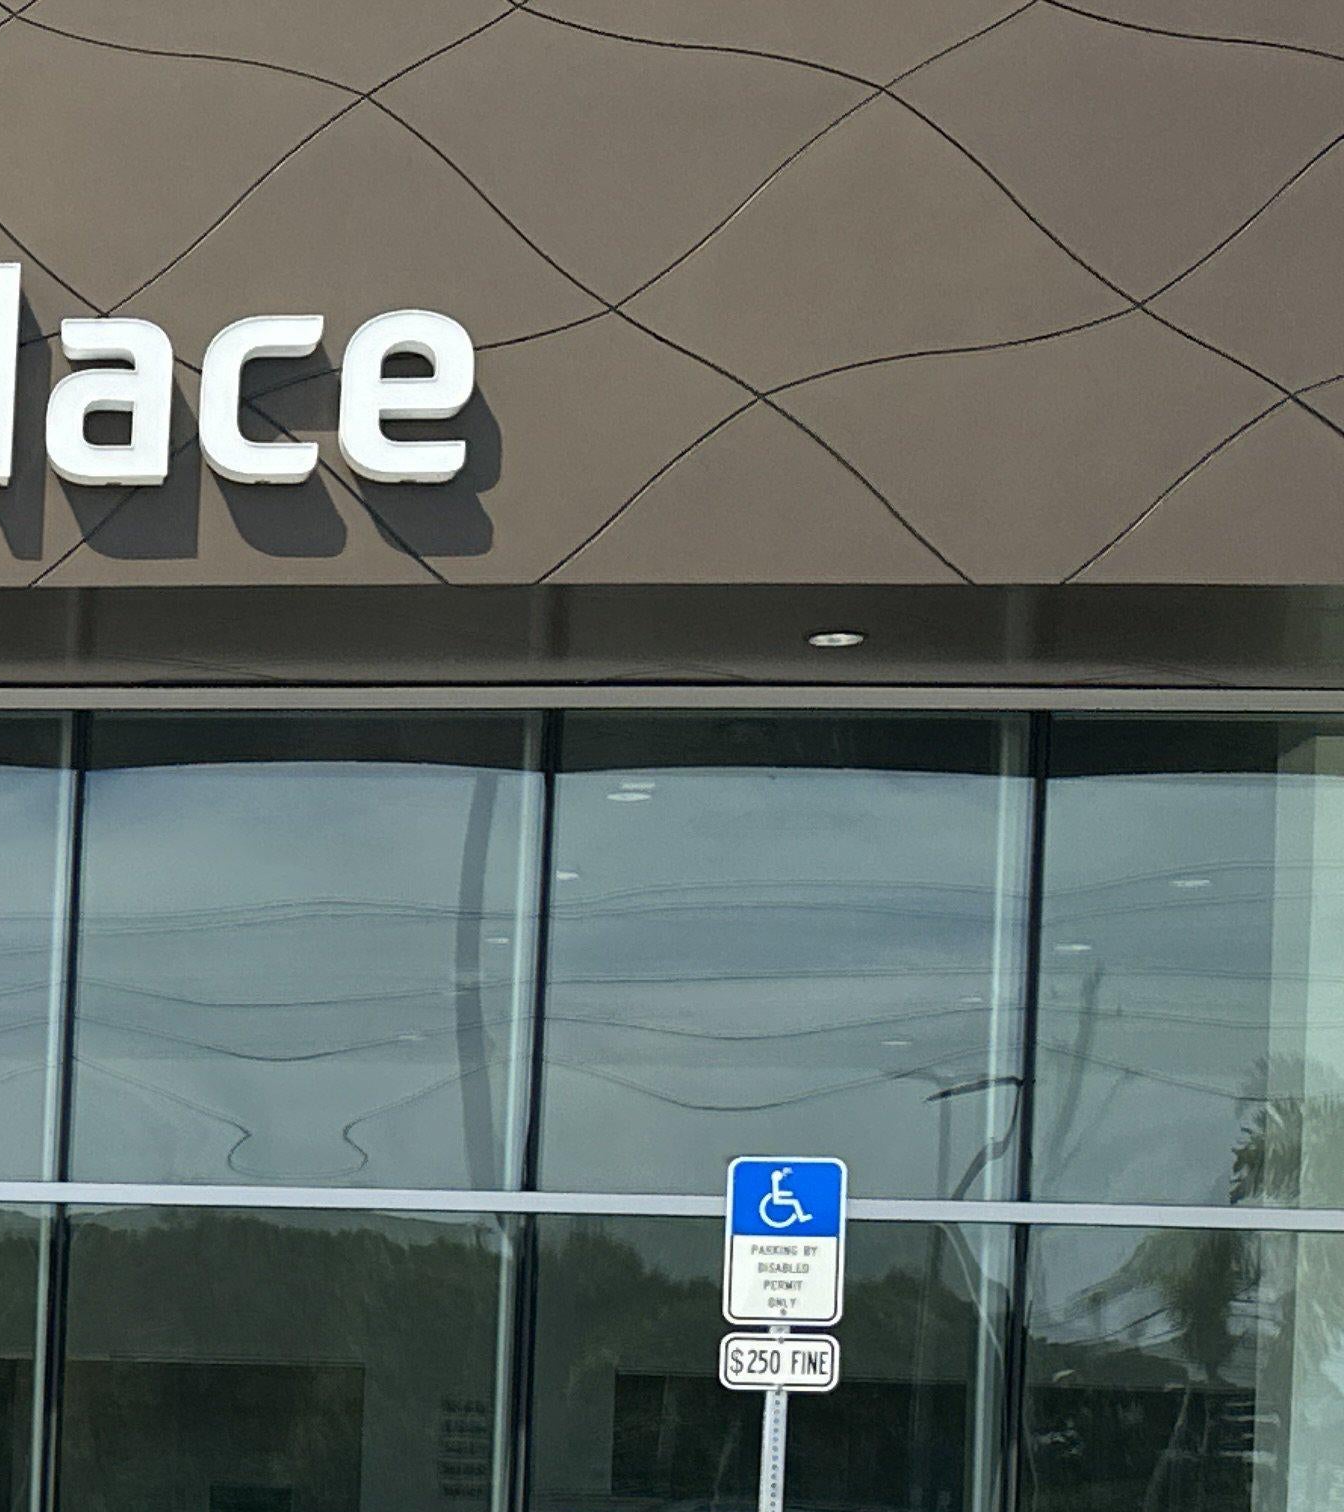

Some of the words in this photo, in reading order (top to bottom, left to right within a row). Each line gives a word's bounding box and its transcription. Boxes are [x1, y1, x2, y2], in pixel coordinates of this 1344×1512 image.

[751, 1245, 798, 1256] PARKING
[803, 1246, 818, 1257] BY
[758, 1262, 809, 1274] DISABLED
[763, 1280, 803, 1291] PERMIT
[768, 1298, 797, 1309] ONLY
[730, 1347, 781, 1376] $250
[792, 1351, 829, 1376] FINE
